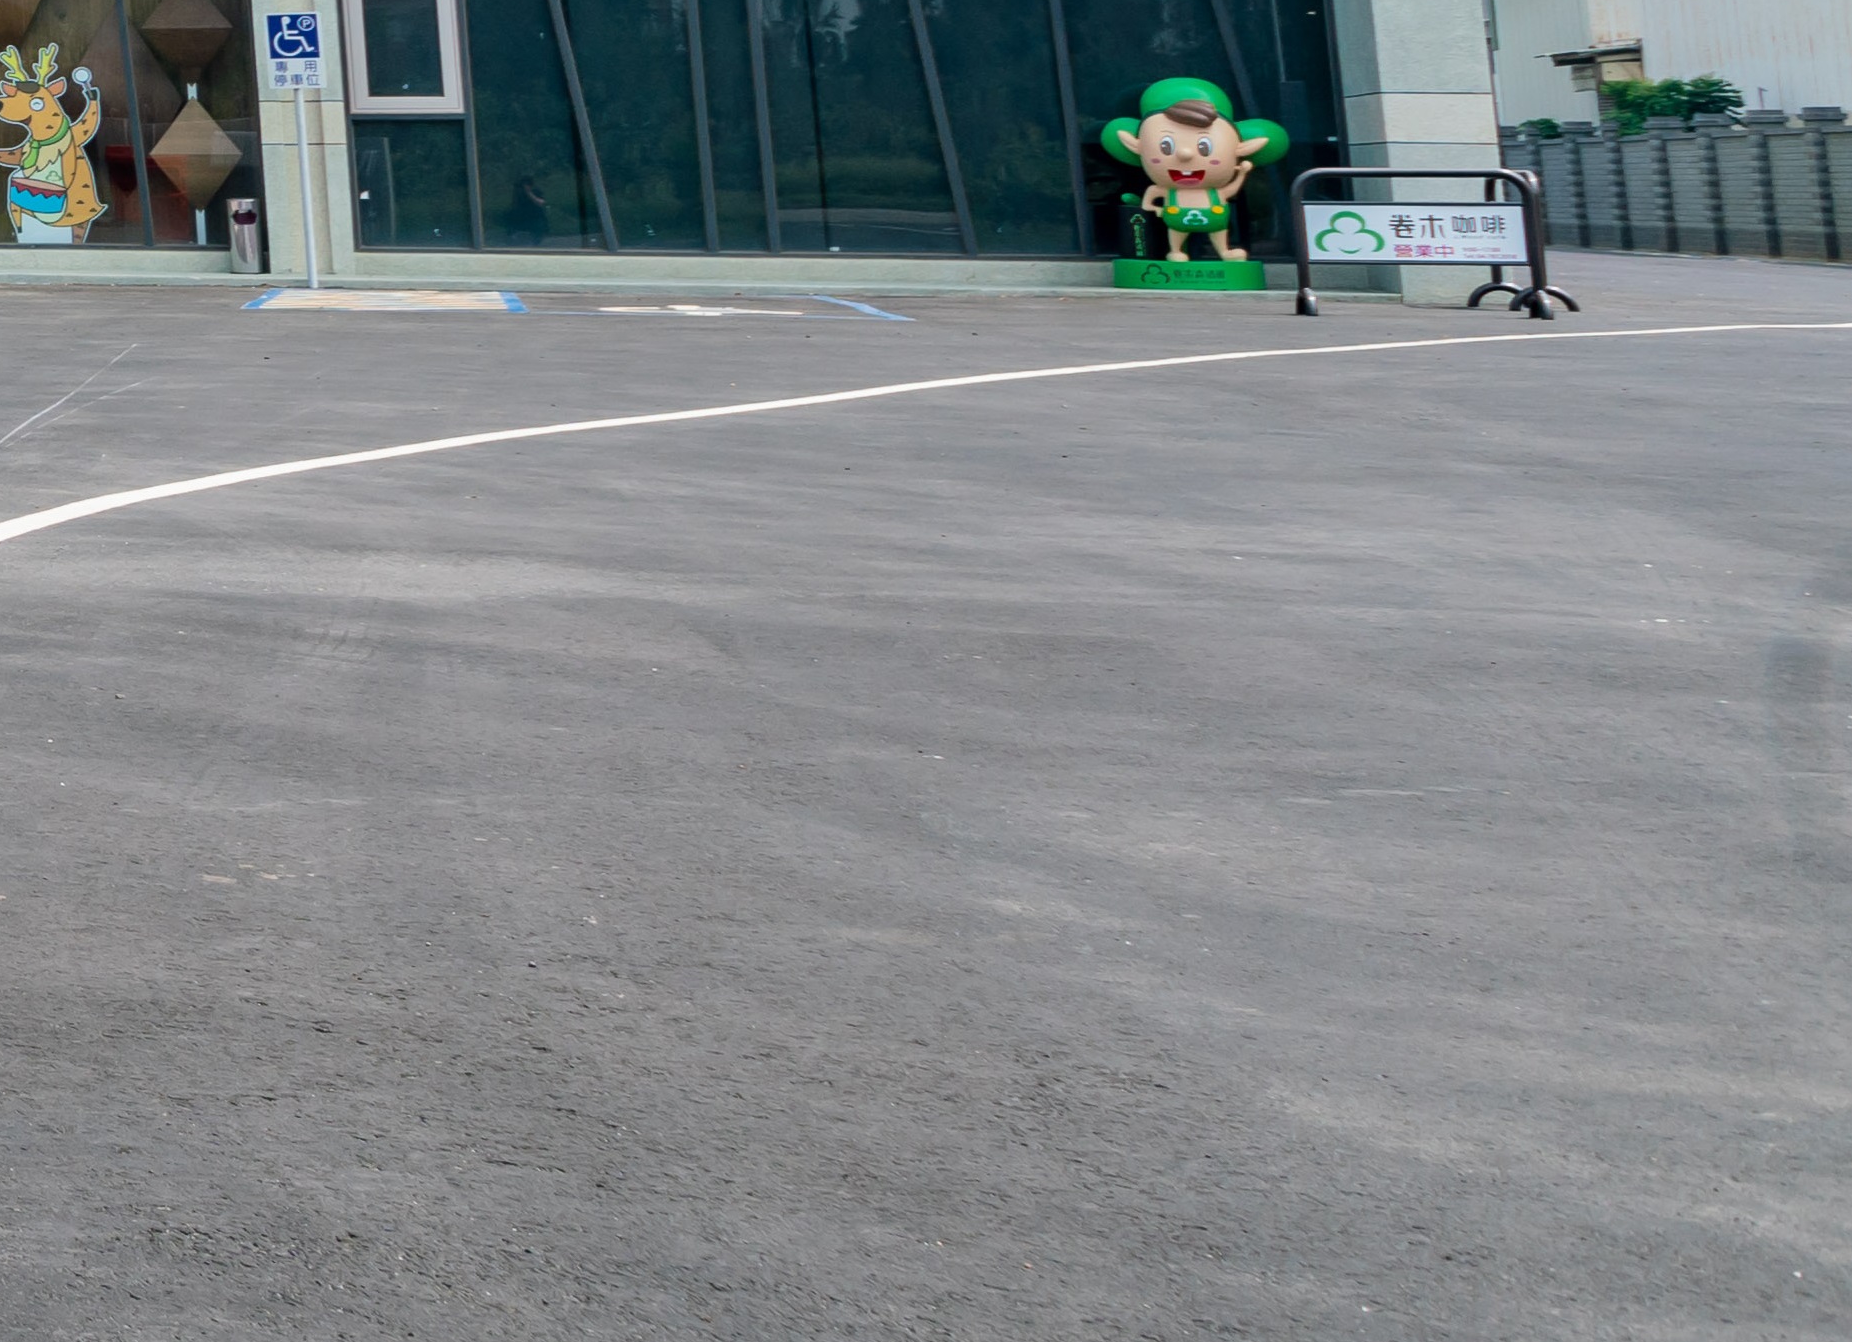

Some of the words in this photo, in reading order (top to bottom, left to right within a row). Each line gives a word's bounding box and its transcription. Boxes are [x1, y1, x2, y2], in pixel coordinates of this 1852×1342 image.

[1389, 215, 1506, 239] 卷木咖啡
[1394, 244, 1455, 258] 營業中
